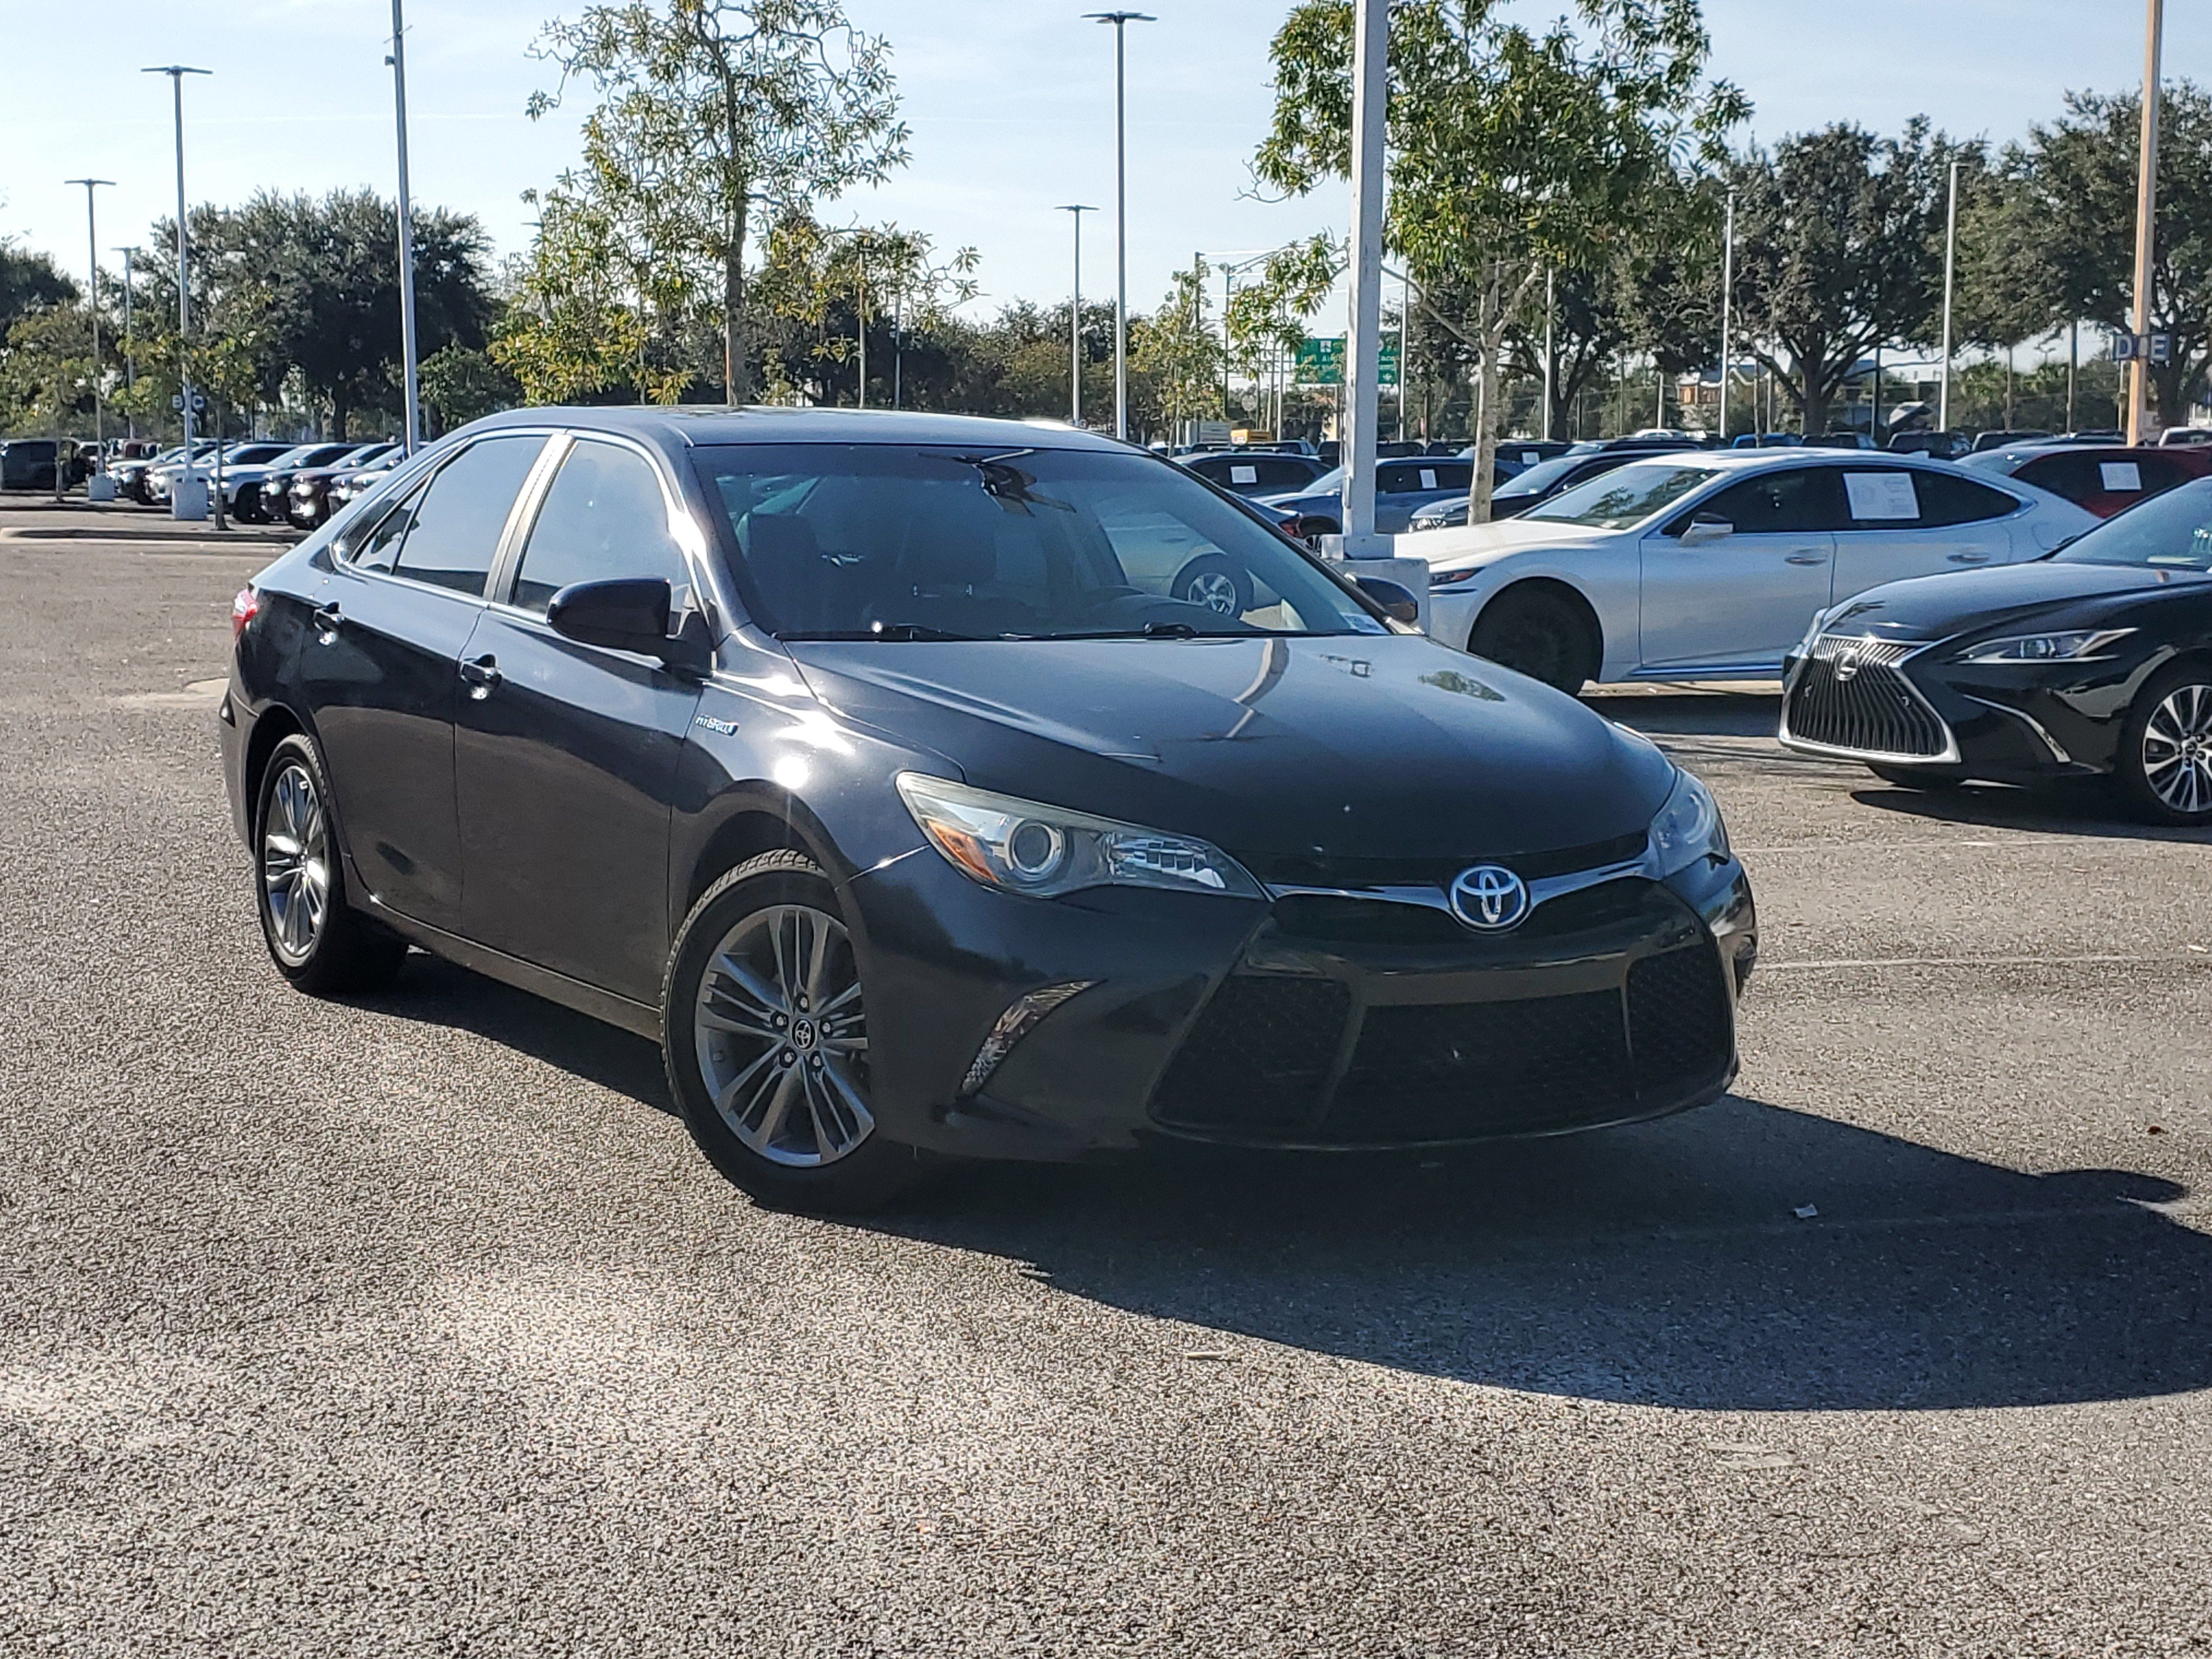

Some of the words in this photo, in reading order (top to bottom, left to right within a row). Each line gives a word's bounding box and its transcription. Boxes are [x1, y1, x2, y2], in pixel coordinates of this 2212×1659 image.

[2115, 335, 2132, 358] D
[2151, 335, 2168, 360] E
[172, 395, 183, 409] B
[193, 395, 204, 409] C
